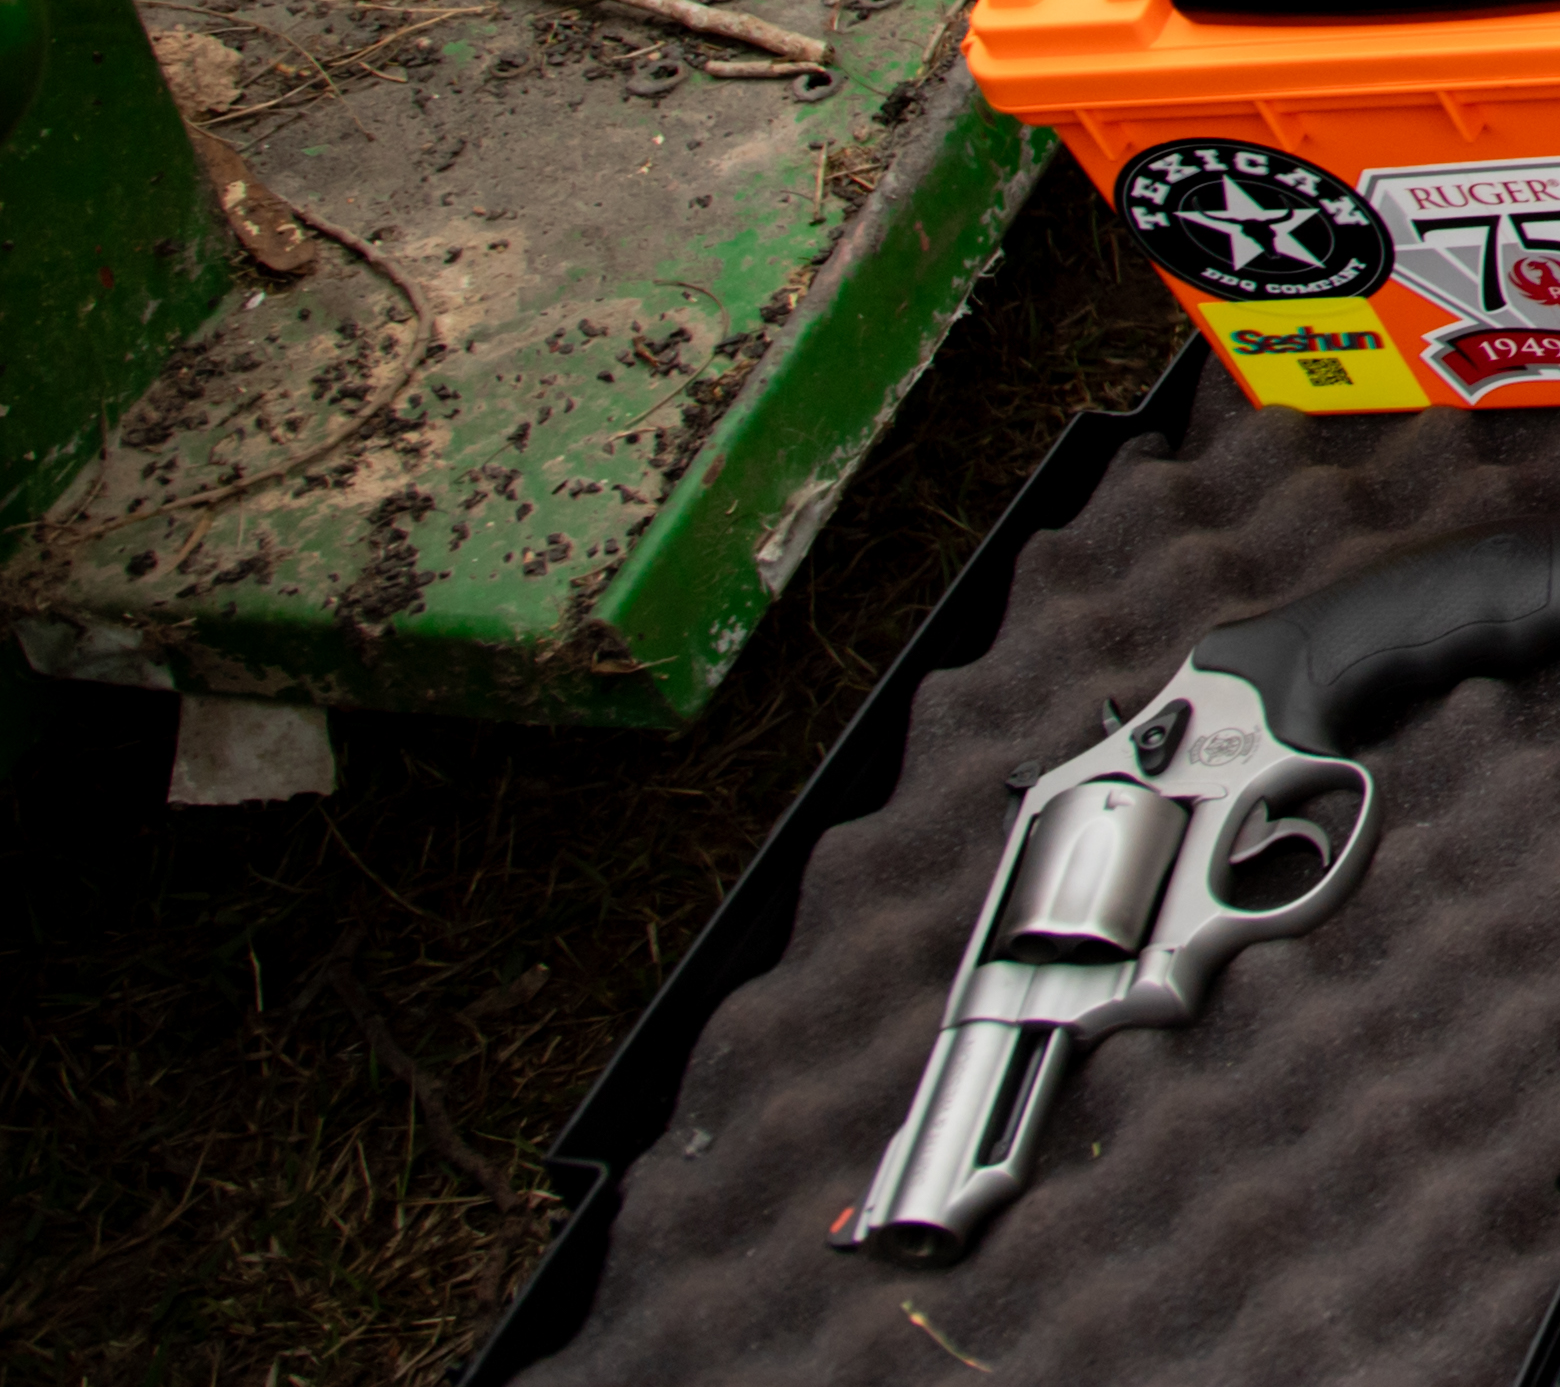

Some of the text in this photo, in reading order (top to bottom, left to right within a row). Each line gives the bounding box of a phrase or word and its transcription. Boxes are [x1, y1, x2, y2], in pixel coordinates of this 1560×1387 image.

[1130, 148, 1371, 231] TEXICAN
[1265, 257, 1368, 294] COMPANY
[1231, 326, 1386, 355] Seshun
